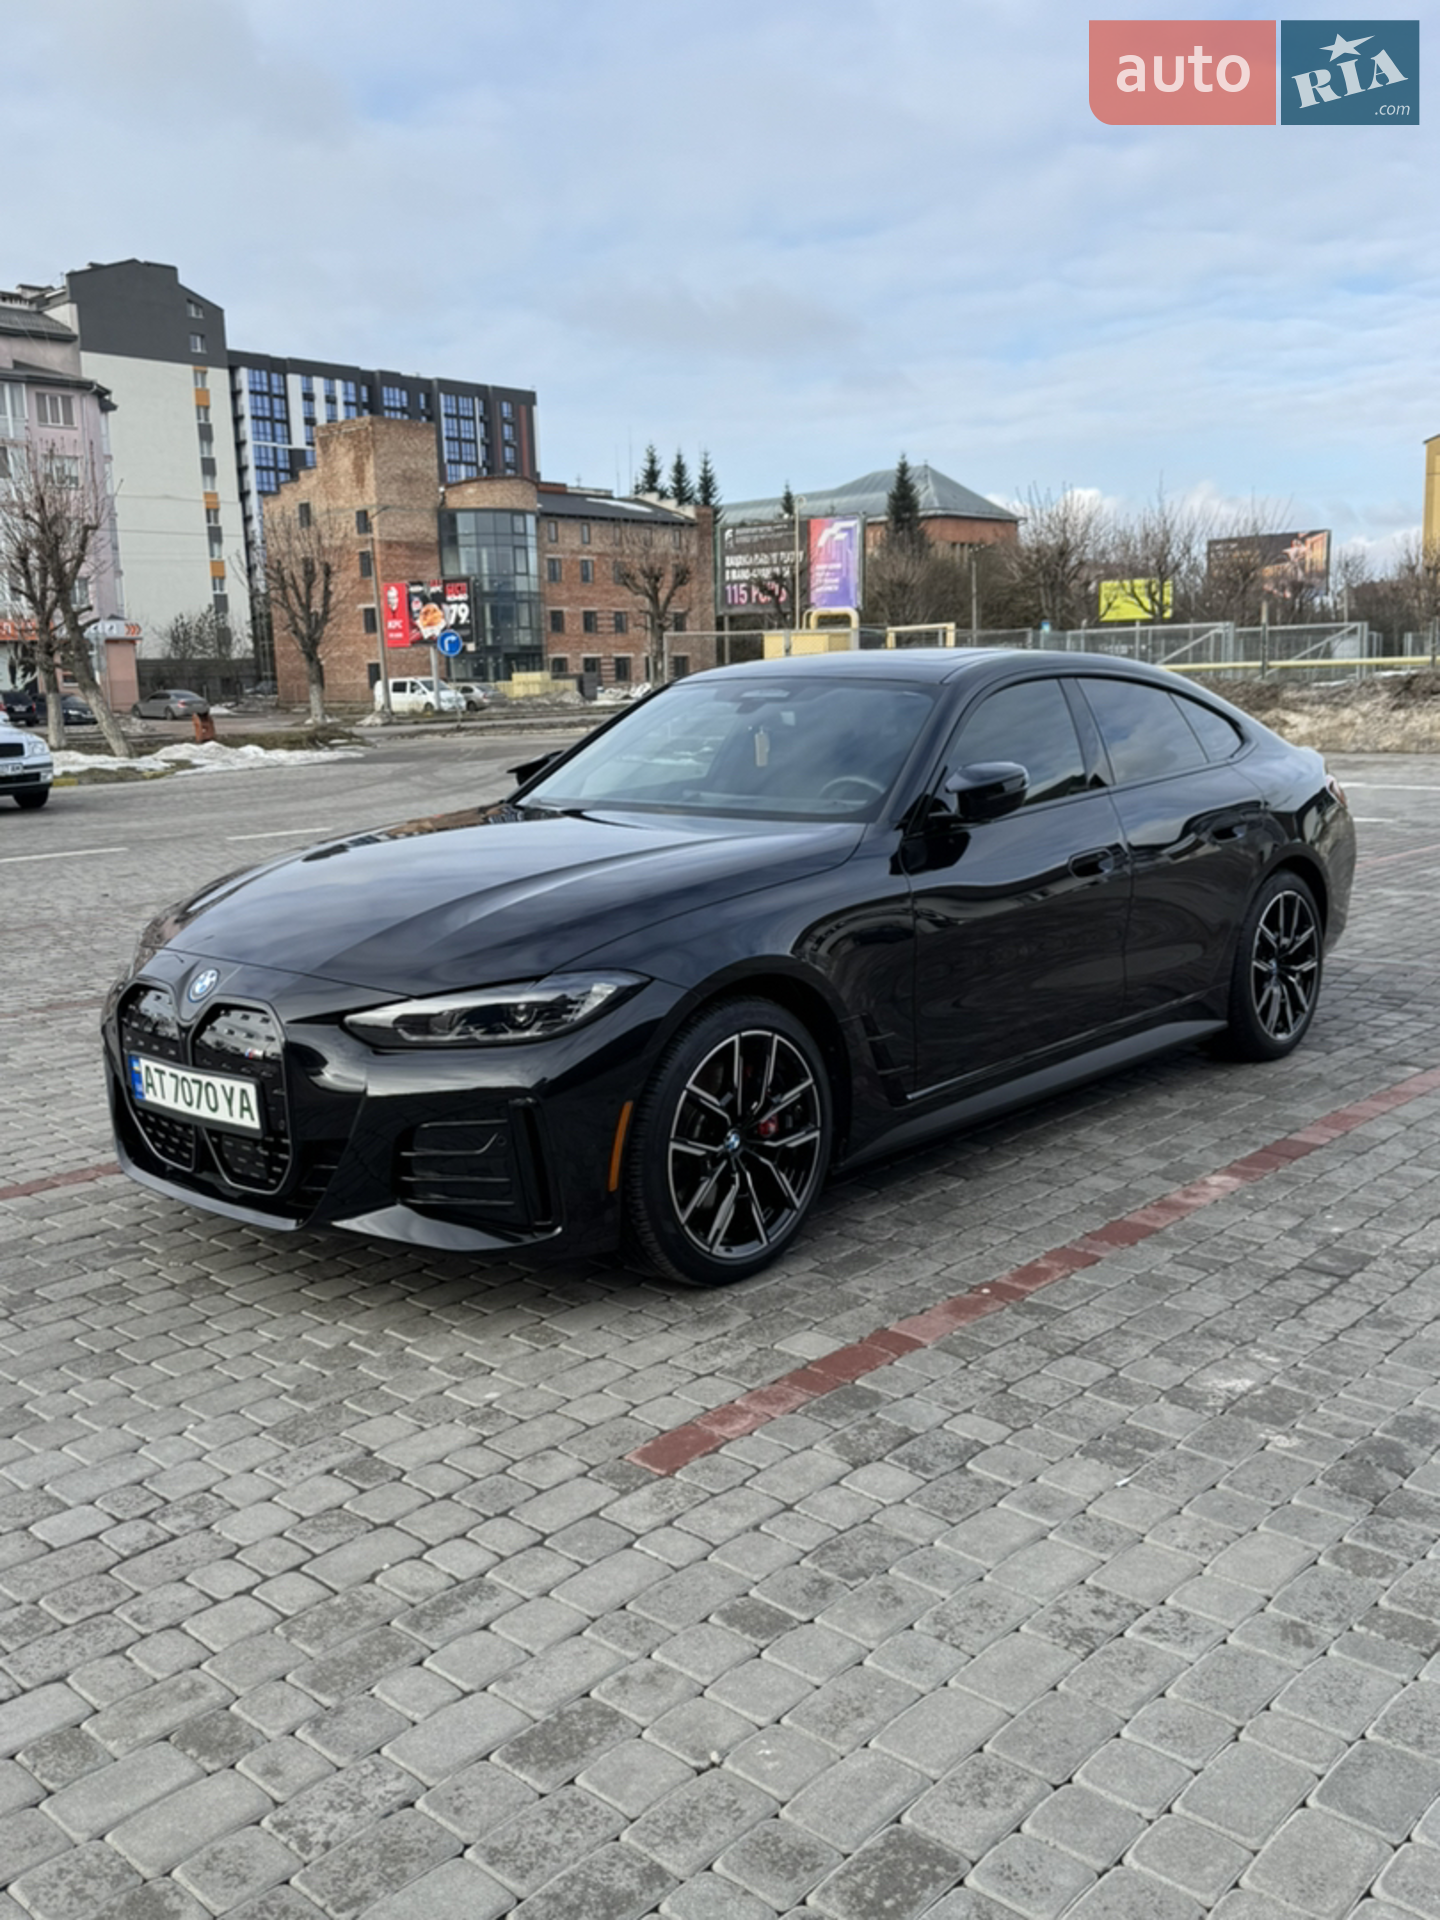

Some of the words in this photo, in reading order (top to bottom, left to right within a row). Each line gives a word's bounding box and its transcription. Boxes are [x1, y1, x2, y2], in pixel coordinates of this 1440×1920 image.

[725, 583, 747, 604] 115
[145, 1065, 166, 1100] AT
[169, 1073, 219, 1113] 7070
[221, 1083, 255, 1122] YA
